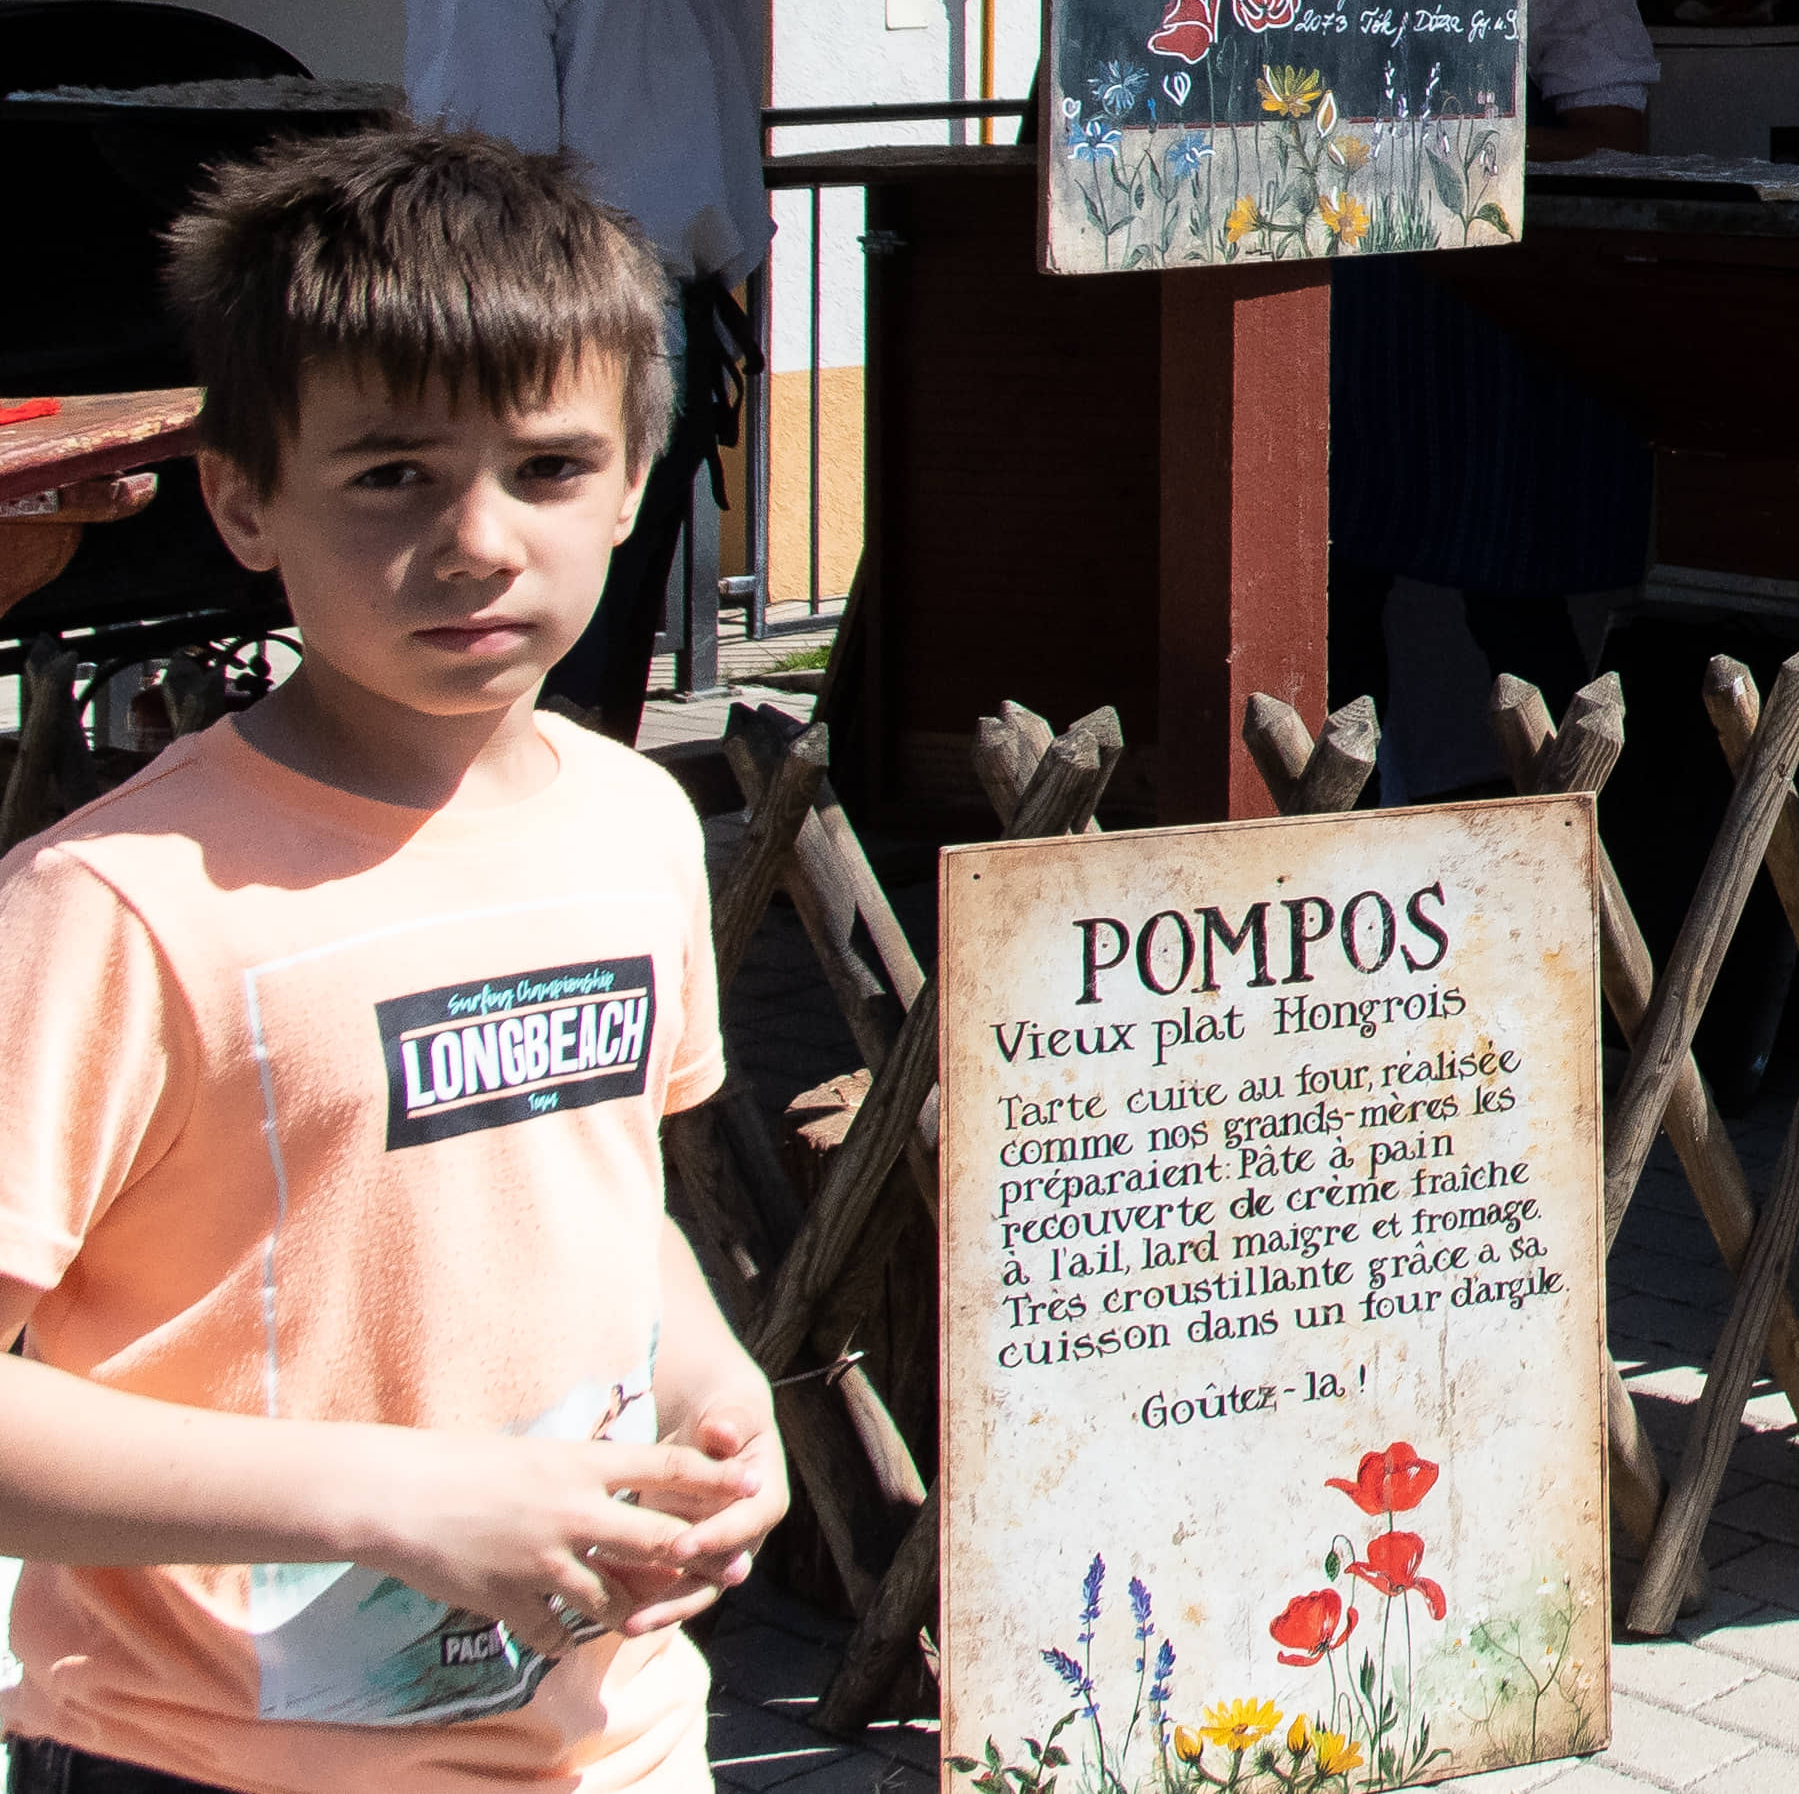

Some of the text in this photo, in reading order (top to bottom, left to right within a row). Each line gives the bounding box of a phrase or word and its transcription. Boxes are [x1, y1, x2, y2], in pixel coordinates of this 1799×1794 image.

[1294, 9, 1348, 36] 2073
[1072, 882, 1448, 1005] POMPOS
[402, 995, 649, 1112] LONGBEACH
[991, 985, 1465, 1066] Vieux plat Hongrois
[997, 1040, 1520, 1130] Tarte cuite au four, réalisée
[999, 1084, 1516, 1167] comme nos grands-mères les
[1237, 1144, 1314, 1179] Pâte
[1328, 1134, 1355, 1169] à
[1368, 1134, 1453, 1179] pain
[1001, 1160, 1528, 1248] recouverte de crème fraîche
[1001, 1198, 1543, 1287] à l'ail, lard maigre et fromage.
[998, 1323, 1169, 1368] cuisson
[1186, 1309, 1278, 1343] dans
[1294, 1302, 1345, 1329] un
[1359, 1283, 1442, 1322] four
[1002, 1288, 1087, 1328] Très
[1103, 1256, 1352, 1313] croustillante
[1368, 1240, 1471, 1293] grâce
[1508, 1235, 1548, 1262] sa
